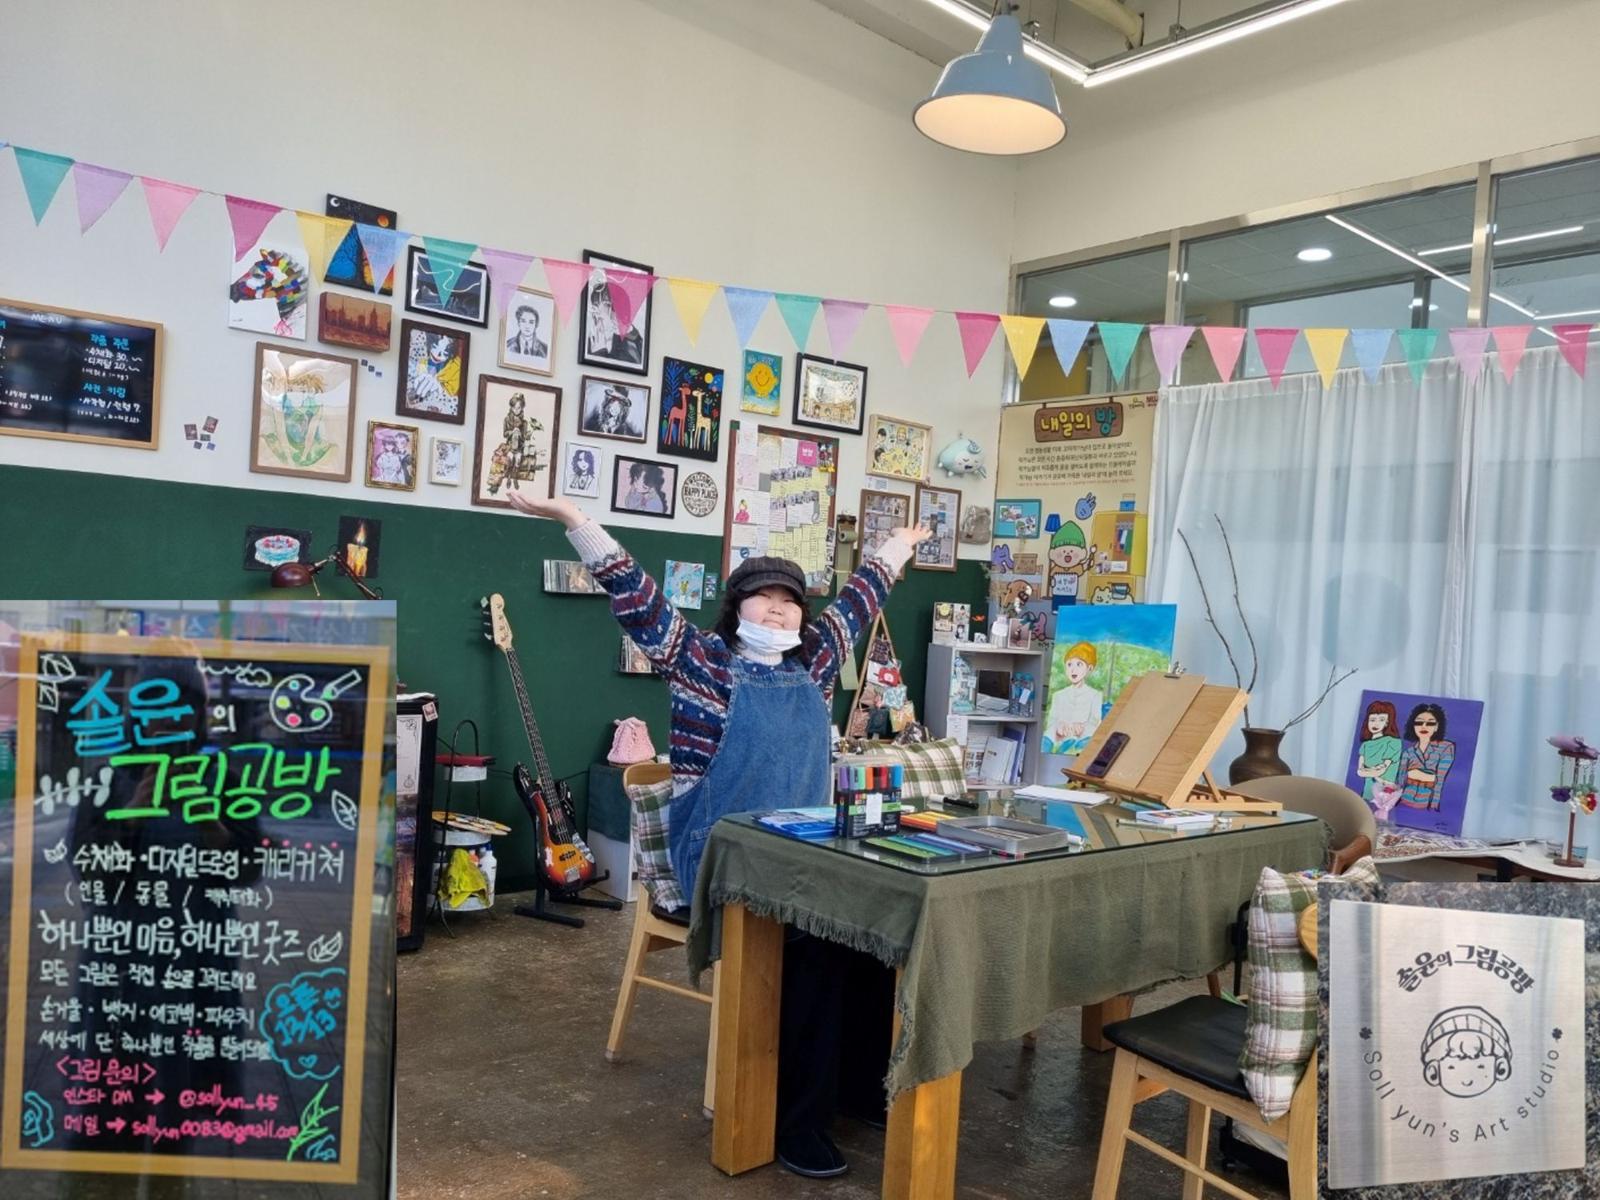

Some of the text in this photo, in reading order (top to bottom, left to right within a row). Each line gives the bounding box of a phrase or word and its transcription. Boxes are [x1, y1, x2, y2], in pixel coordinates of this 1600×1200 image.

[1041, 406, 1117, 437] 내일의 방
[105, 743, 342, 824] 그림공방
[37, 909, 132, 951] 하나뿐인
[262, 920, 304, 966] 굿즈
[40, 959, 69, 987] 모든
[78, 961, 119, 987] 그림은
[128, 963, 155, 988] 직접
[1396, 944, 1535, 994] 솔윤의 그림공방
[40, 994, 82, 1023] 손거울
[204, 1005, 255, 1031] 파우치
[39, 1030, 87, 1051] 세상에
[95, 1032, 112, 1053] 단
[120, 1032, 176, 1057] 하나뿐인
[112, 1090, 134, 1105] DM
[1364, 1050, 1560, 1143] Soll yun's Art studio
[64, 1115, 101, 1136] 메일
